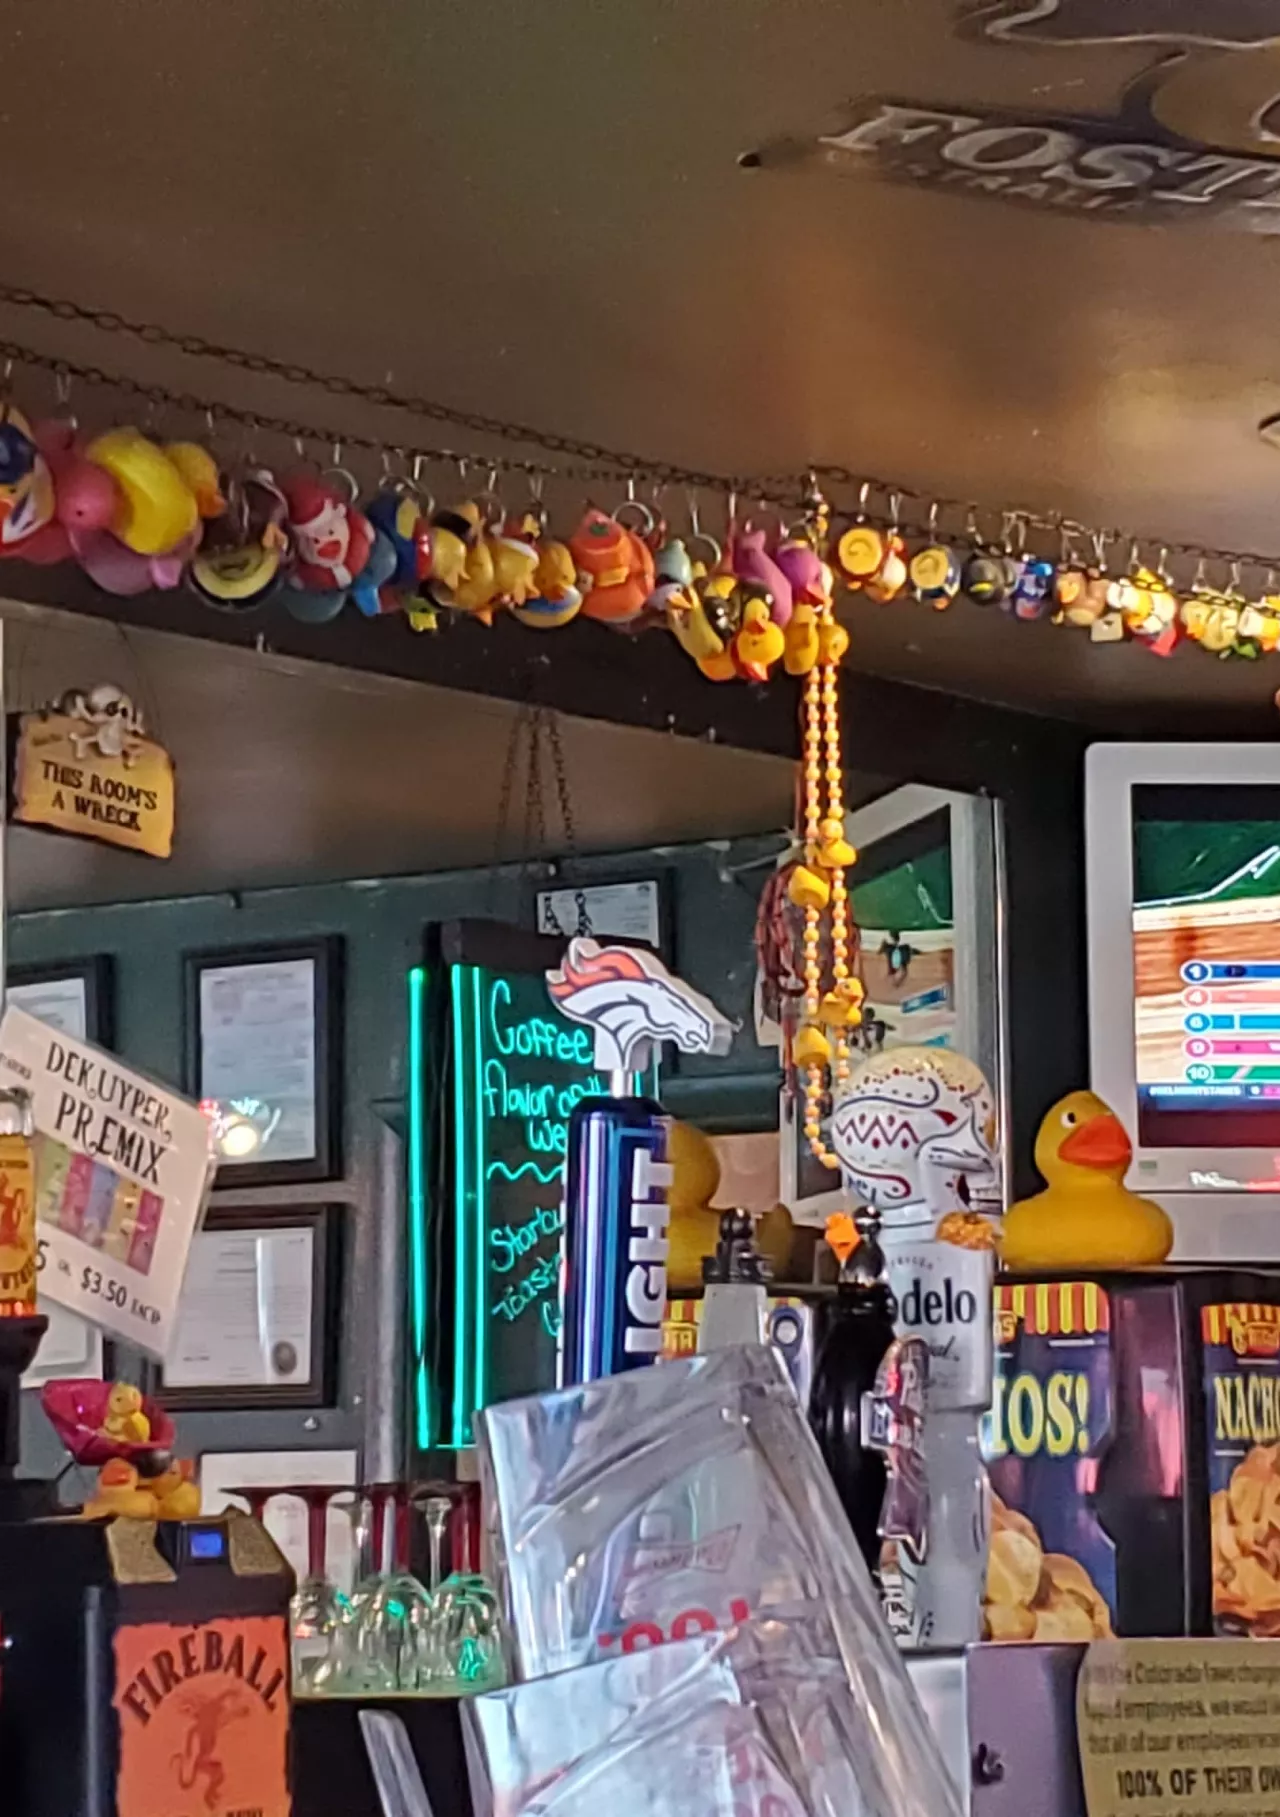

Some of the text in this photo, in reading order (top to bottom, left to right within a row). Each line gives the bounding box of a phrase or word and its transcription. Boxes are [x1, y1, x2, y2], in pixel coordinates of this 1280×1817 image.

[41, 760, 84, 789] THIS
[52, 790, 141, 832] A WRECK
[491, 979, 594, 1064] Coffee
[54, 1092, 167, 1185] PREMIX
[623, 1147, 674, 1354] IGHT
[81, 1265, 127, 1308] $3.50
[901, 1277, 977, 1326] delo
[122, 1630, 284, 1727] FIREBALL
[1117, 1769, 1163, 1798] 100%
[1169, 1767, 1197, 1796] OF
[1203, 1766, 1253, 1794] THEIR
